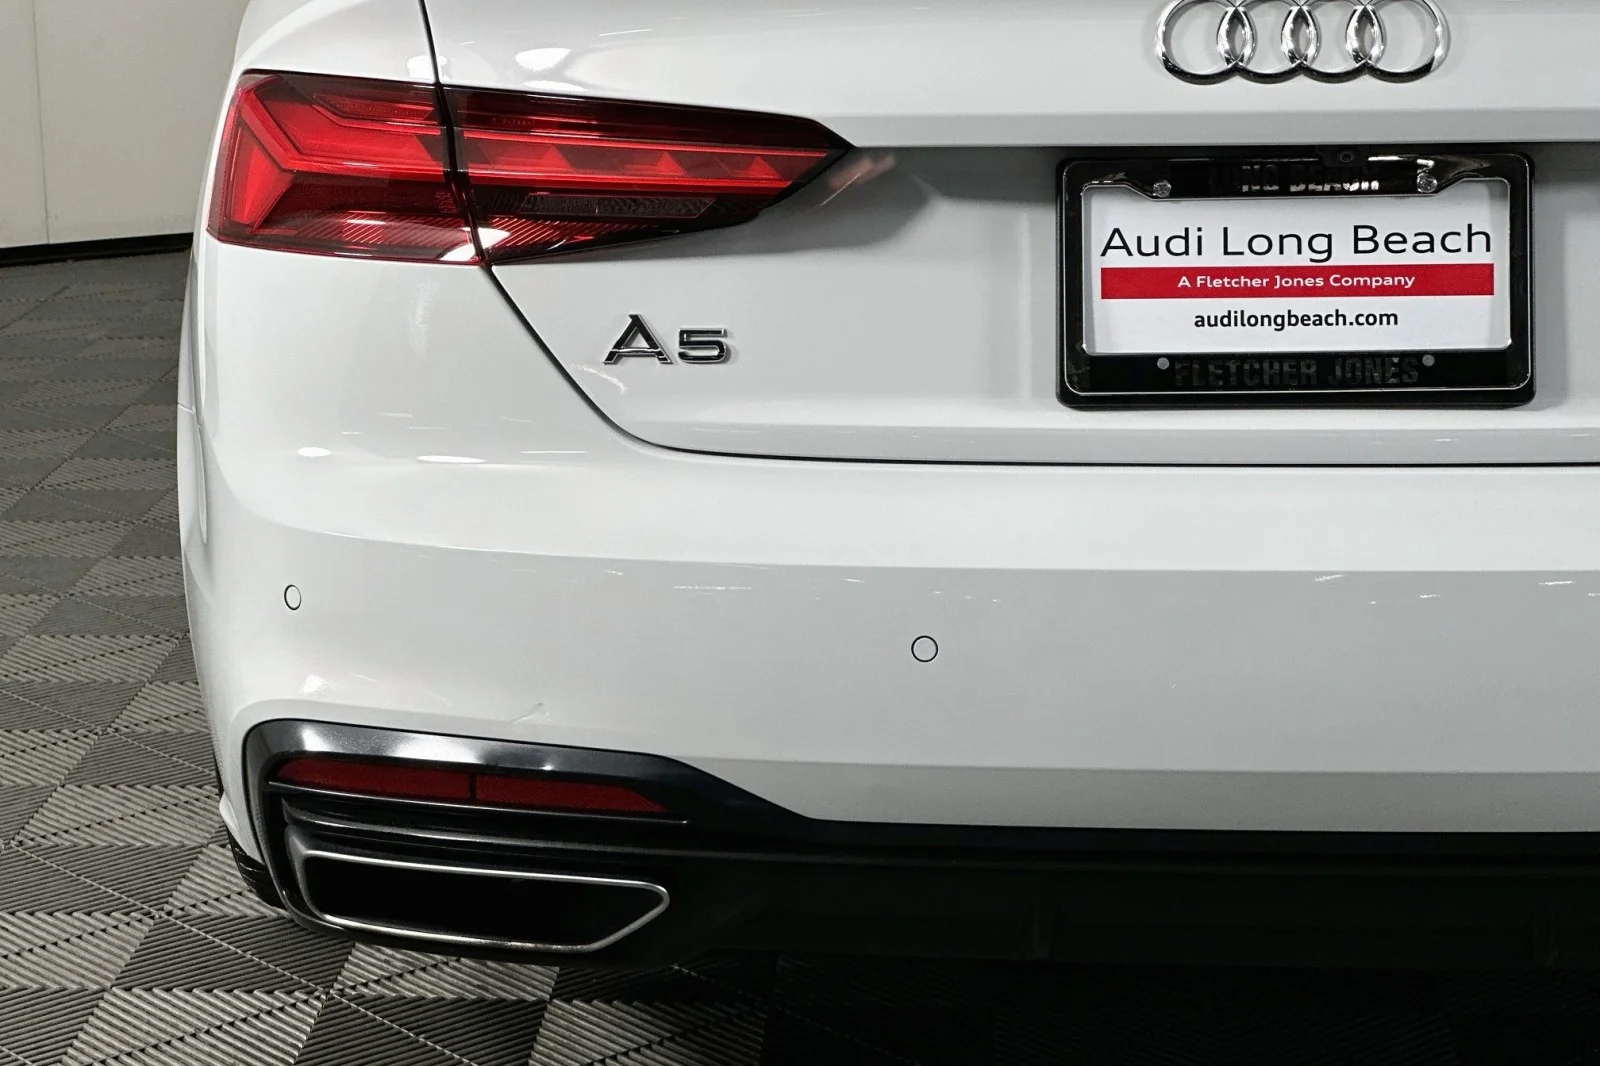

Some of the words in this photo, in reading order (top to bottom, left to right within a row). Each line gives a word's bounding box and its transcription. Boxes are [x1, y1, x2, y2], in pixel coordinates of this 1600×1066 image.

[1100, 226, 1203, 257] Audi
[1223, 226, 1333, 263] Long
[1353, 223, 1491, 255] Beach
[1177, 275, 1192, 288] A
[1196, 275, 1270, 288] Fletcher
[1274, 274, 1324, 289] Jones
[1329, 274, 1416, 289] Company
[1194, 308, 1398, 332] audilongbeach.com
[602, 313, 728, 365] A5
[1174, 358, 1318, 387] FLETCHER
[1327, 356, 1419, 385] JONES
